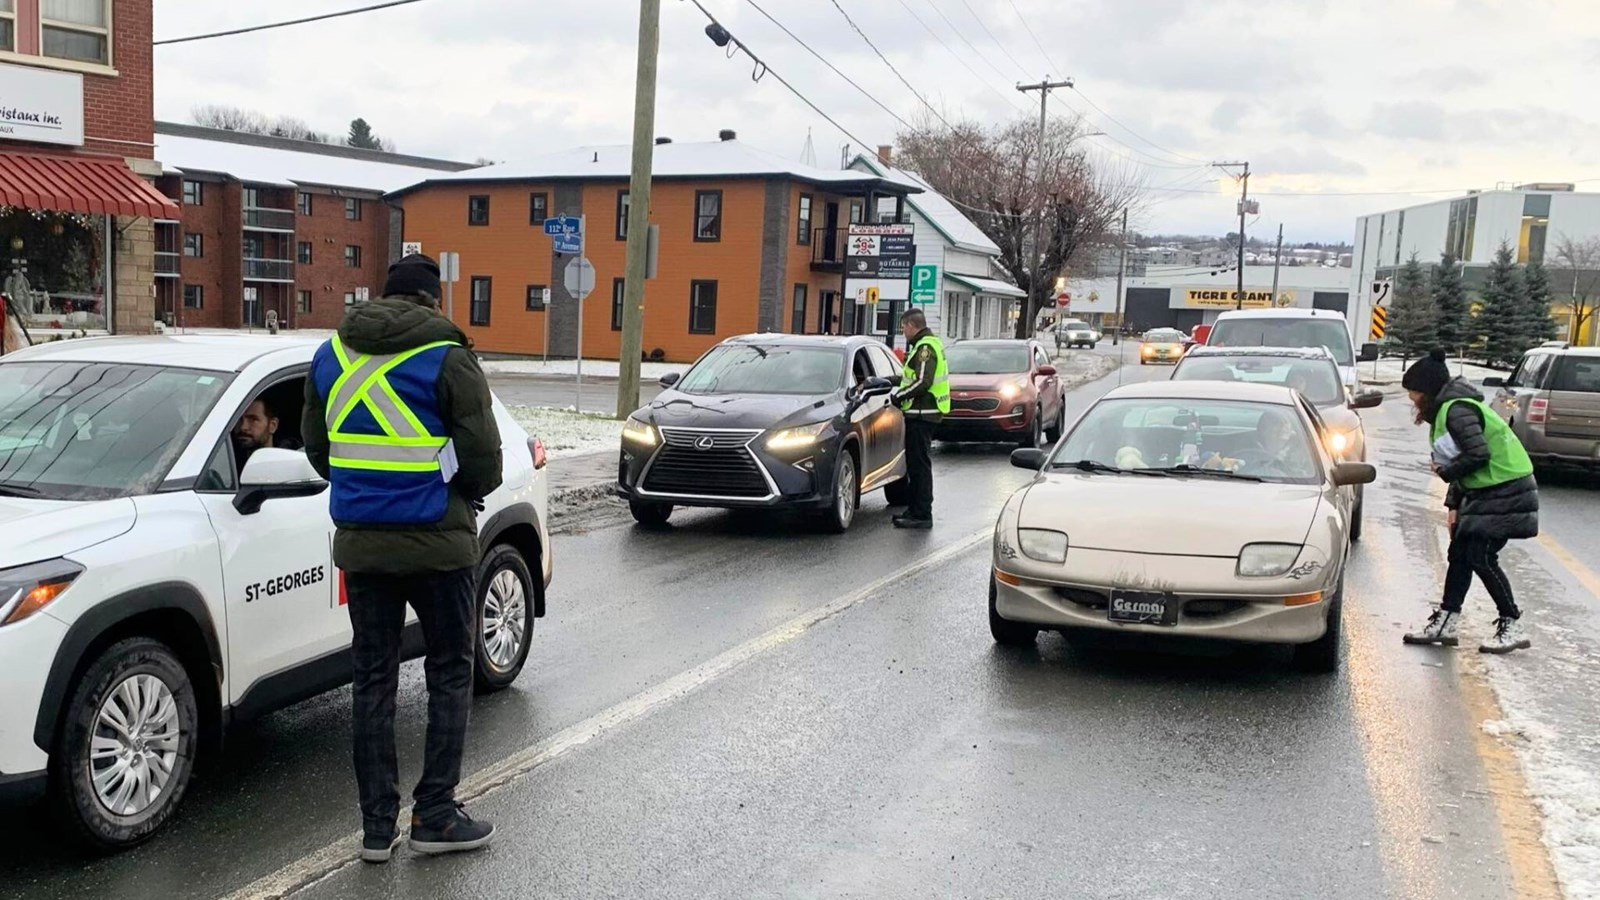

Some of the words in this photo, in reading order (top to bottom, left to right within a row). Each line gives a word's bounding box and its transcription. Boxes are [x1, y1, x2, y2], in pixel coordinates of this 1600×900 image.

[43, 111, 62, 125] inc.
[562, 224, 575, 232] Rue
[917, 268, 931, 287] P
[1189, 291, 1228, 300] TIGRE
[245, 565, 324, 603] ST-GEORGES
